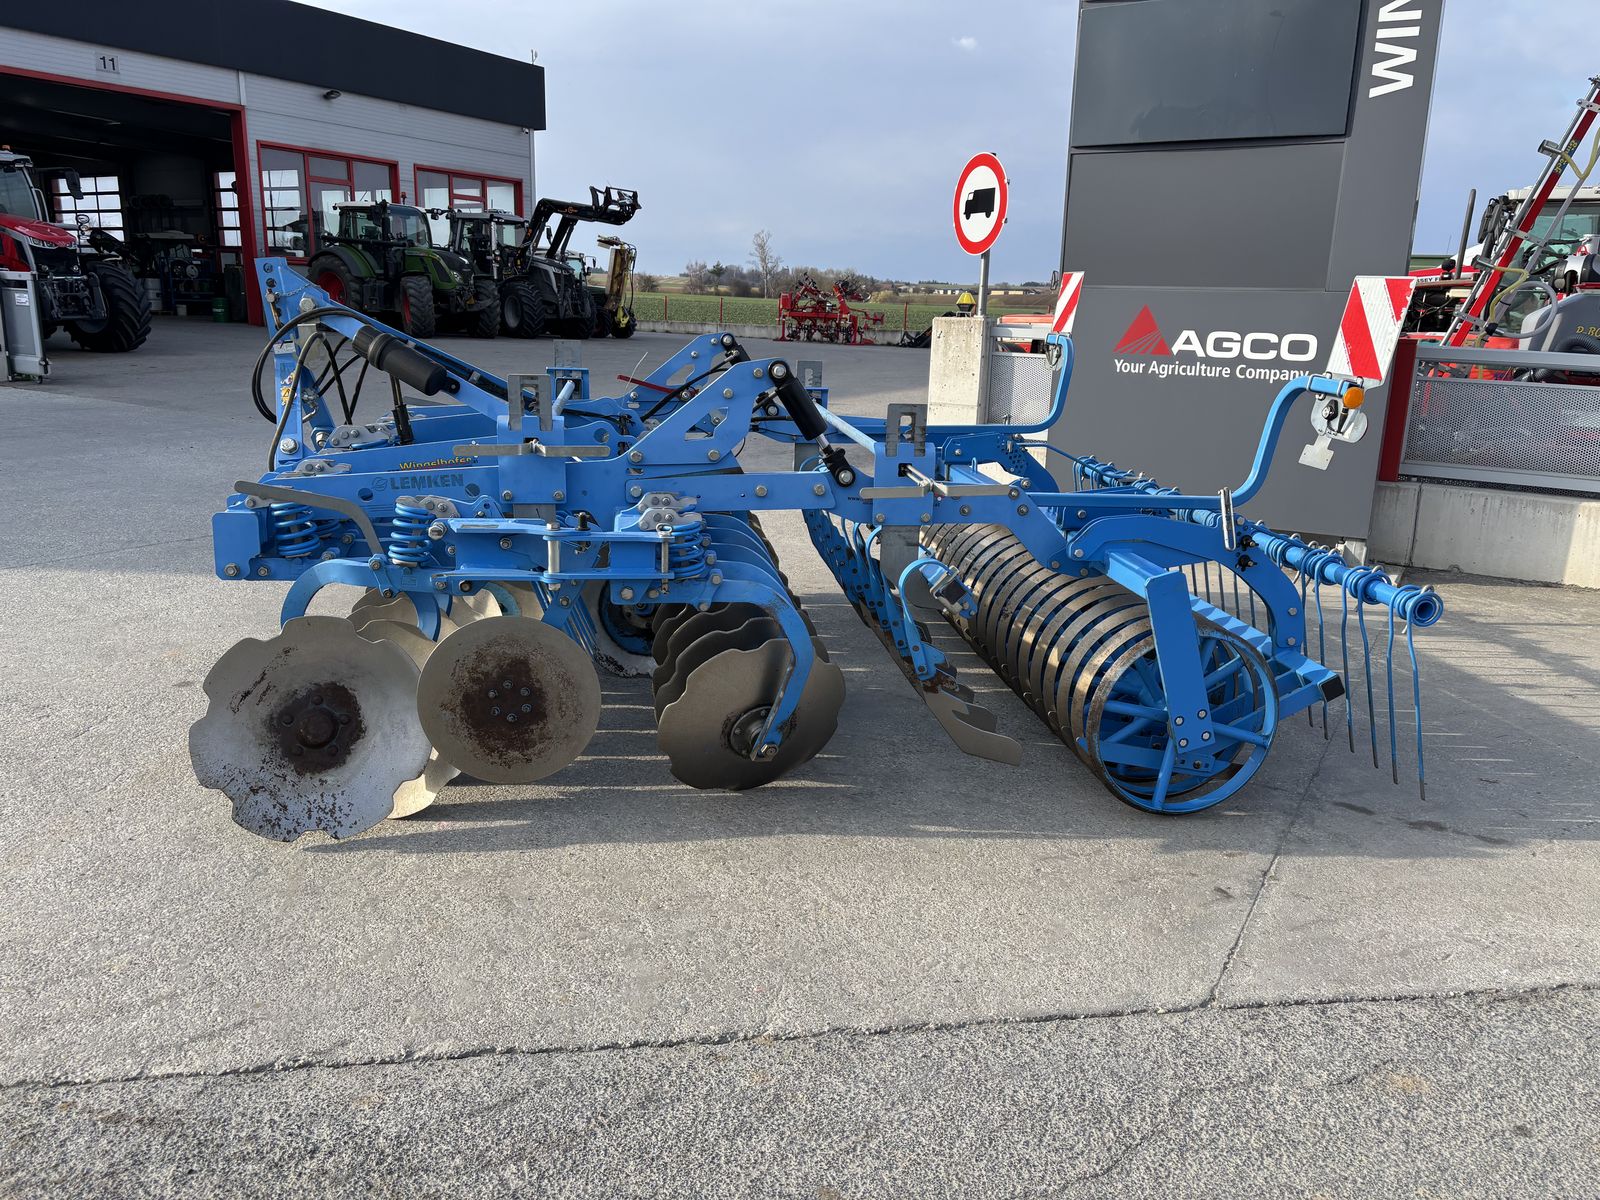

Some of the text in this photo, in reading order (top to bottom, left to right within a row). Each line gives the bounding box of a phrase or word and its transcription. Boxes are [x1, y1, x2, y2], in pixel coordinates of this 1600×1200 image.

[1368, 0, 1422, 98] WIN
[100, 56, 115, 71] 11
[1171, 330, 1318, 362] AGCO
[1114, 359, 1146, 374] Your
[1148, 360, 1231, 378] Agriculture
[389, 473, 464, 490] LEMKEN
